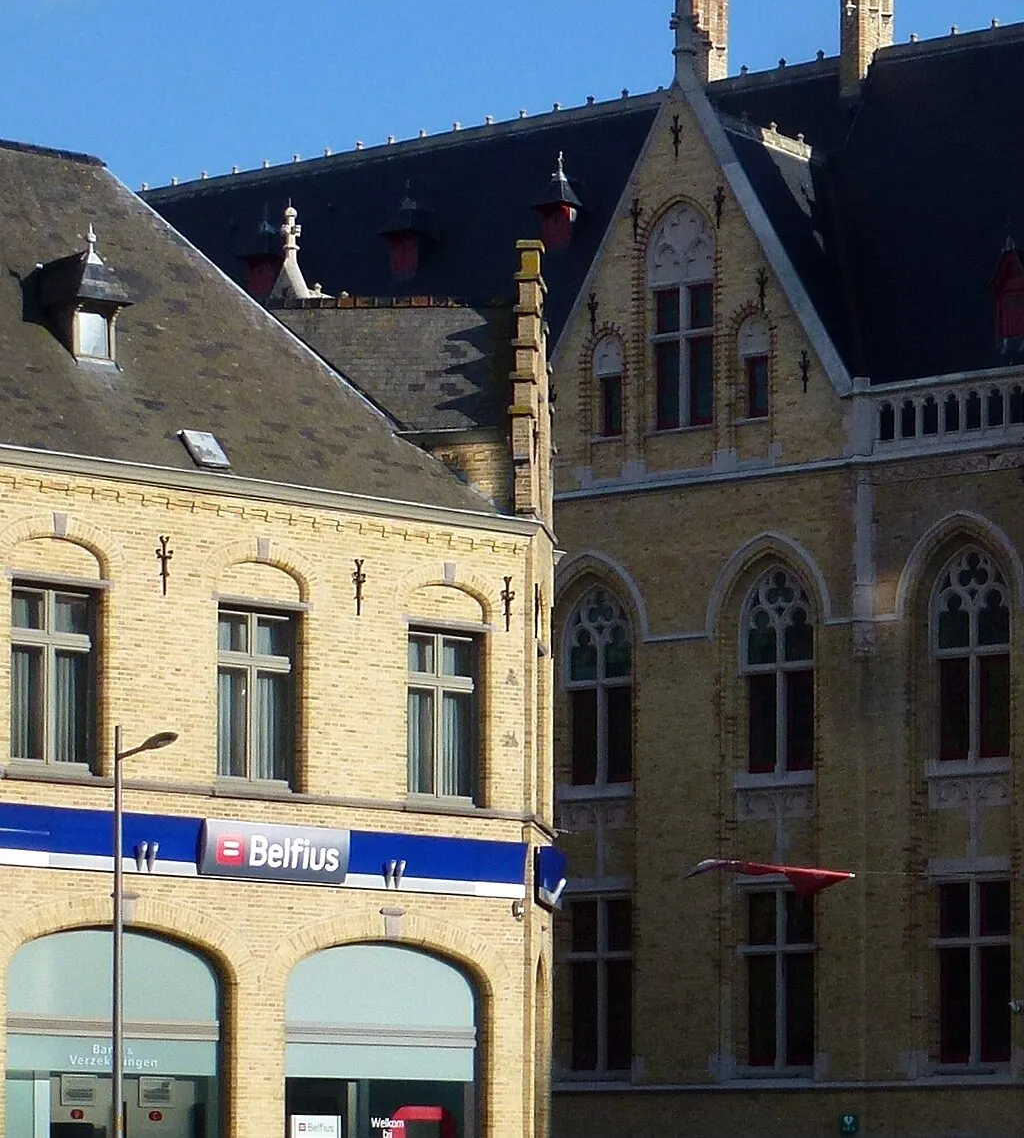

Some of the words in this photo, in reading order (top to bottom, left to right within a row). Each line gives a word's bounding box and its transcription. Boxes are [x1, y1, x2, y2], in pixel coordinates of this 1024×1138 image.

[249, 834, 340, 872] Belfius
[92, 1044, 113, 1054] Ban
[69, 1054, 158, 1069] Verzekingen
[307, 1122, 335, 1133] Belfius
[371, 1116, 404, 1128] Welkom
